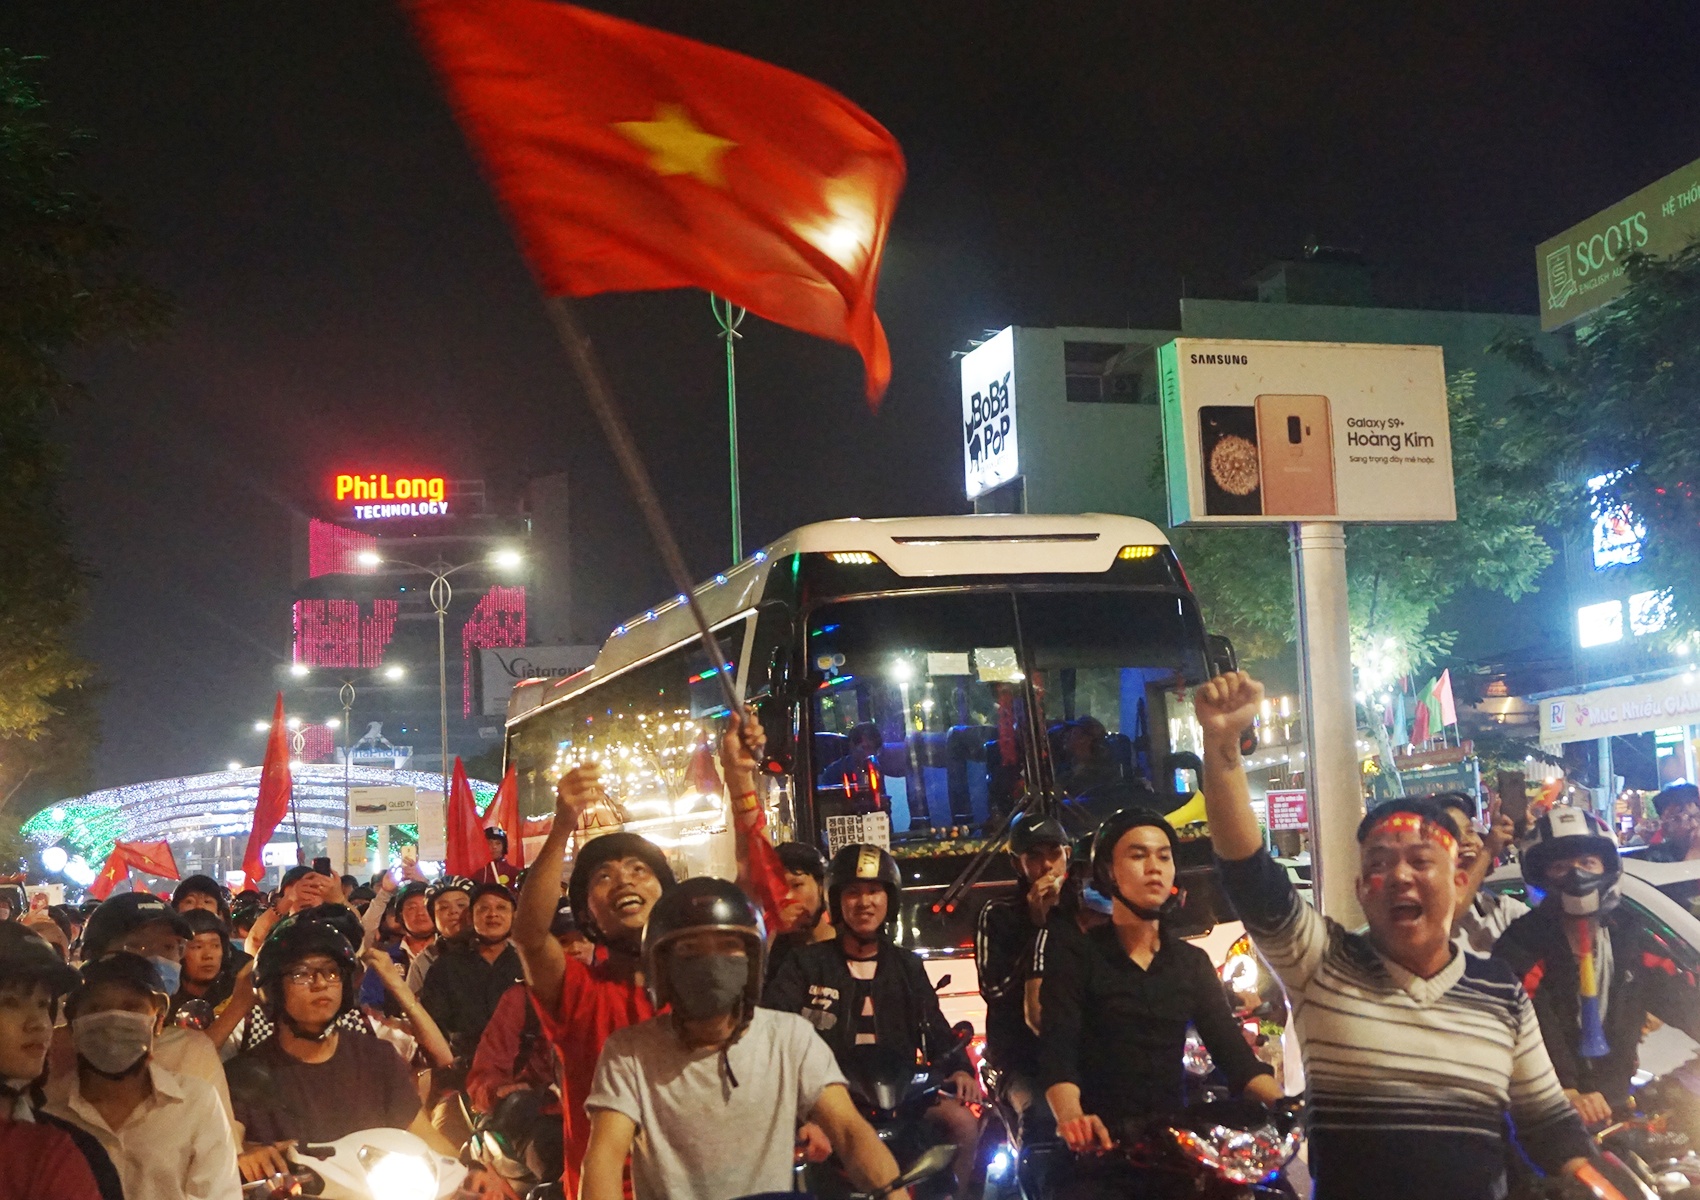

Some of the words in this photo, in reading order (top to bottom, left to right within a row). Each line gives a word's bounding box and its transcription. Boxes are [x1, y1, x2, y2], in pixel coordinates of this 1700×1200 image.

[1576, 211, 1649, 276] SCOTS
[1190, 353, 1248, 365] SAMSUNG
[1346, 417, 1386, 430] Galaxy
[1387, 418, 1404, 428] S9+
[1347, 430, 1401, 451] Hoàng
[1404, 431, 1434, 447] Kim
[1349, 455, 1367, 464] Sang
[354, 502, 448, 519] TECHNOLOGY
[1589, 707, 1618, 726] Mua
